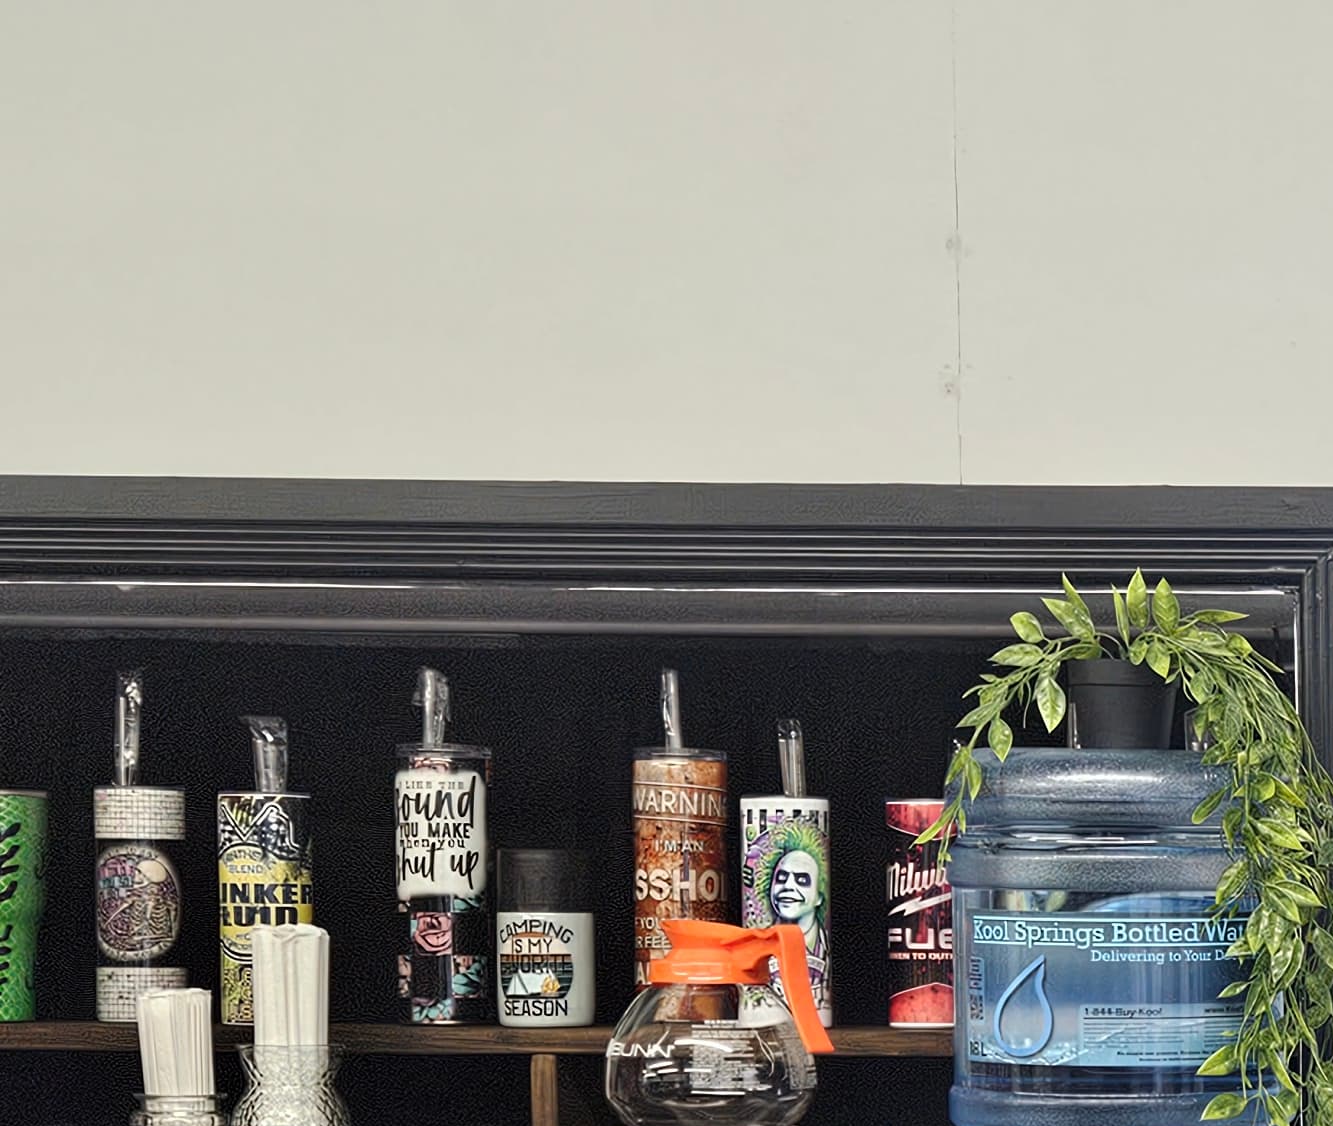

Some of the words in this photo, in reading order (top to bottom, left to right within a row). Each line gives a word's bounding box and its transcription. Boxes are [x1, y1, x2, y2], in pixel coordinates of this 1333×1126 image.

[395, 776, 477, 829] ound
[427, 822, 471, 839] MAKE
[396, 842, 436, 885] hut
[450, 850, 479, 890] up
[499, 918, 574, 944] CAMPING
[973, 921, 1009, 941] Kool
[1014, 921, 1105, 949] Springs
[1111, 922, 1200, 943] Bottled
[528, 938, 553, 954] MY
[1090, 949, 1165, 964] Delivering
[1168, 951, 1182, 962] to
[1184, 950, 1213, 962] Your
[504, 999, 568, 1017] SEASON
